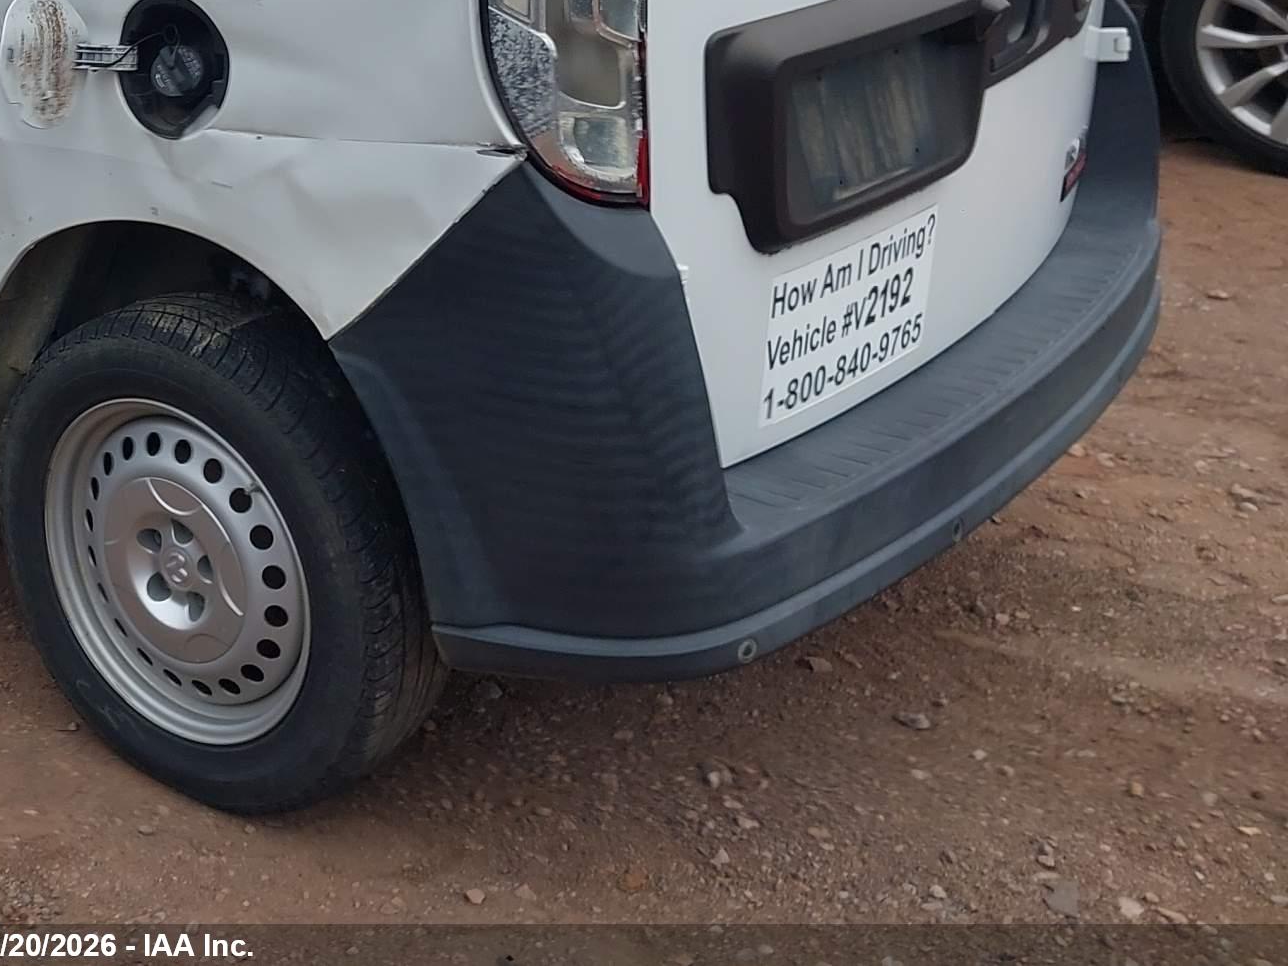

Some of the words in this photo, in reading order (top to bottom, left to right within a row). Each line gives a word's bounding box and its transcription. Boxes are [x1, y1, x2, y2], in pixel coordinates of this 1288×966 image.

[767, 316, 837, 371] Vehicle
[841, 267, 914, 338] #V2192
[770, 279, 817, 319] How
[820, 263, 852, 299] Am
[857, 249, 865, 281] I
[868, 213, 936, 276] Driving?
[763, 312, 923, 419] 1-800-840-9765
